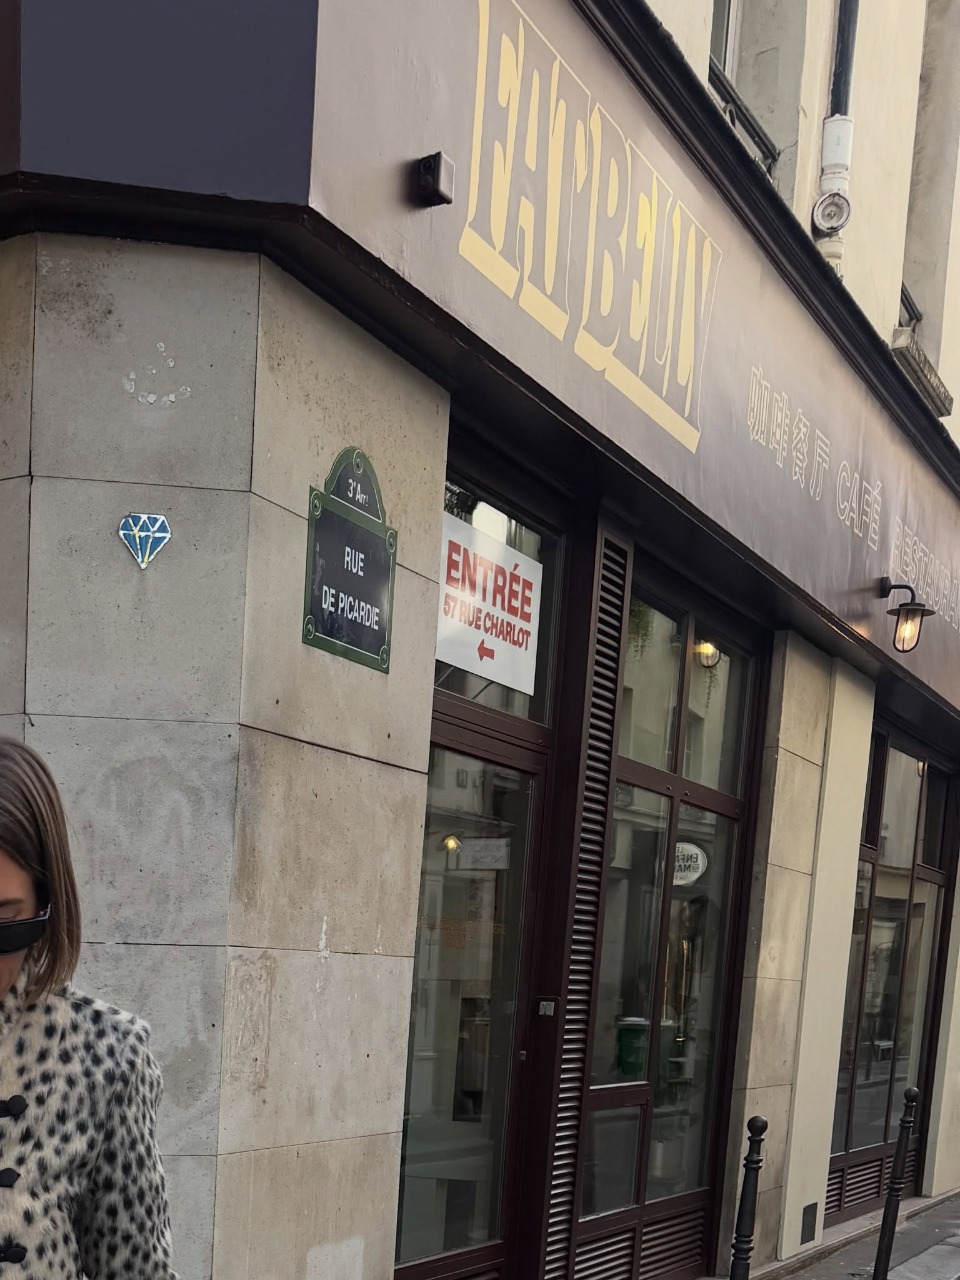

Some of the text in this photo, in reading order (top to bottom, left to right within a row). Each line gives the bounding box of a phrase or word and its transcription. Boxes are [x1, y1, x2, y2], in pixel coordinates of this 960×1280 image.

[344, 546, 365, 577] RUE
[836, 460, 882, 551] CAFÉ
[890, 515, 960, 636] RESTAURA
[321, 585, 380, 631] DE PICARDIE
[445, 539, 533, 624] ENTRÉE
[443, 592, 532, 651] 57 RUE CHARLOT
